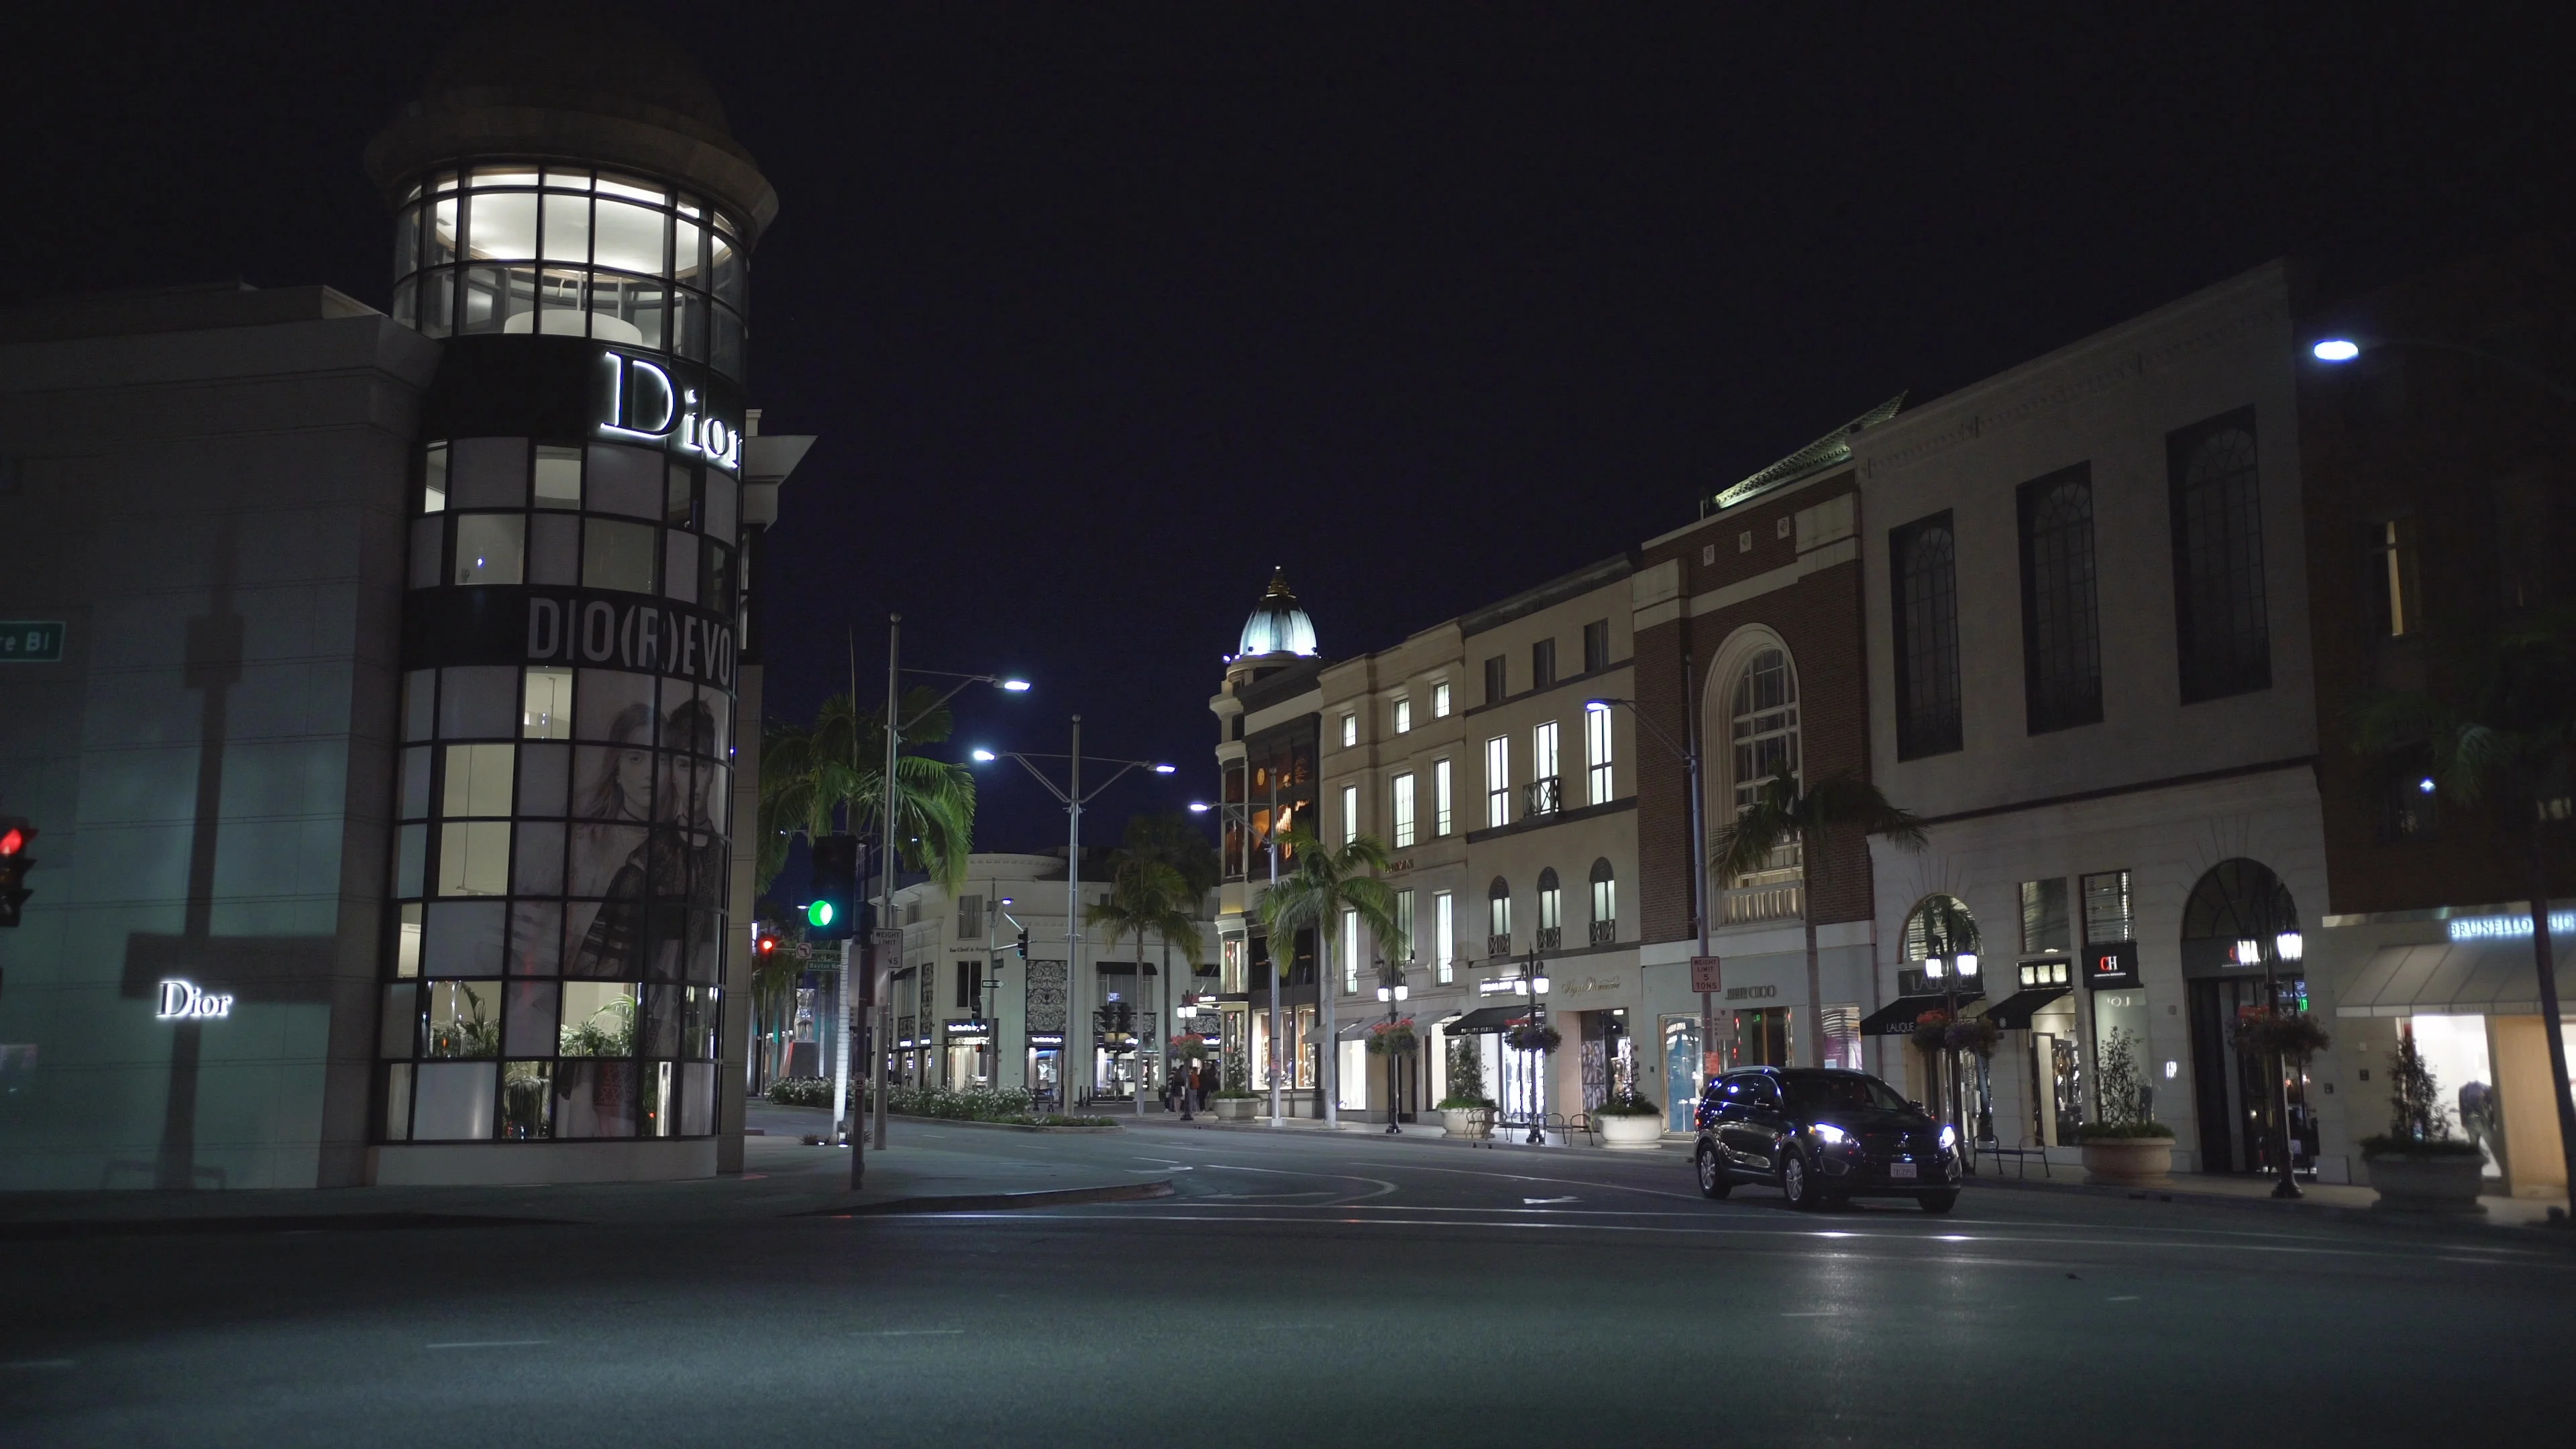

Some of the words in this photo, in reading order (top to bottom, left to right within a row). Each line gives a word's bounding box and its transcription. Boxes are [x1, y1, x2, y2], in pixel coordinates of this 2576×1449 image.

[600, 351, 743, 470] Dior
[2451, 919, 2530, 936] BRUNELLO
[2100, 956, 2118, 971] CH
[156, 980, 233, 1017] Dior
[1886, 1022, 1915, 1032] LALIQUE
